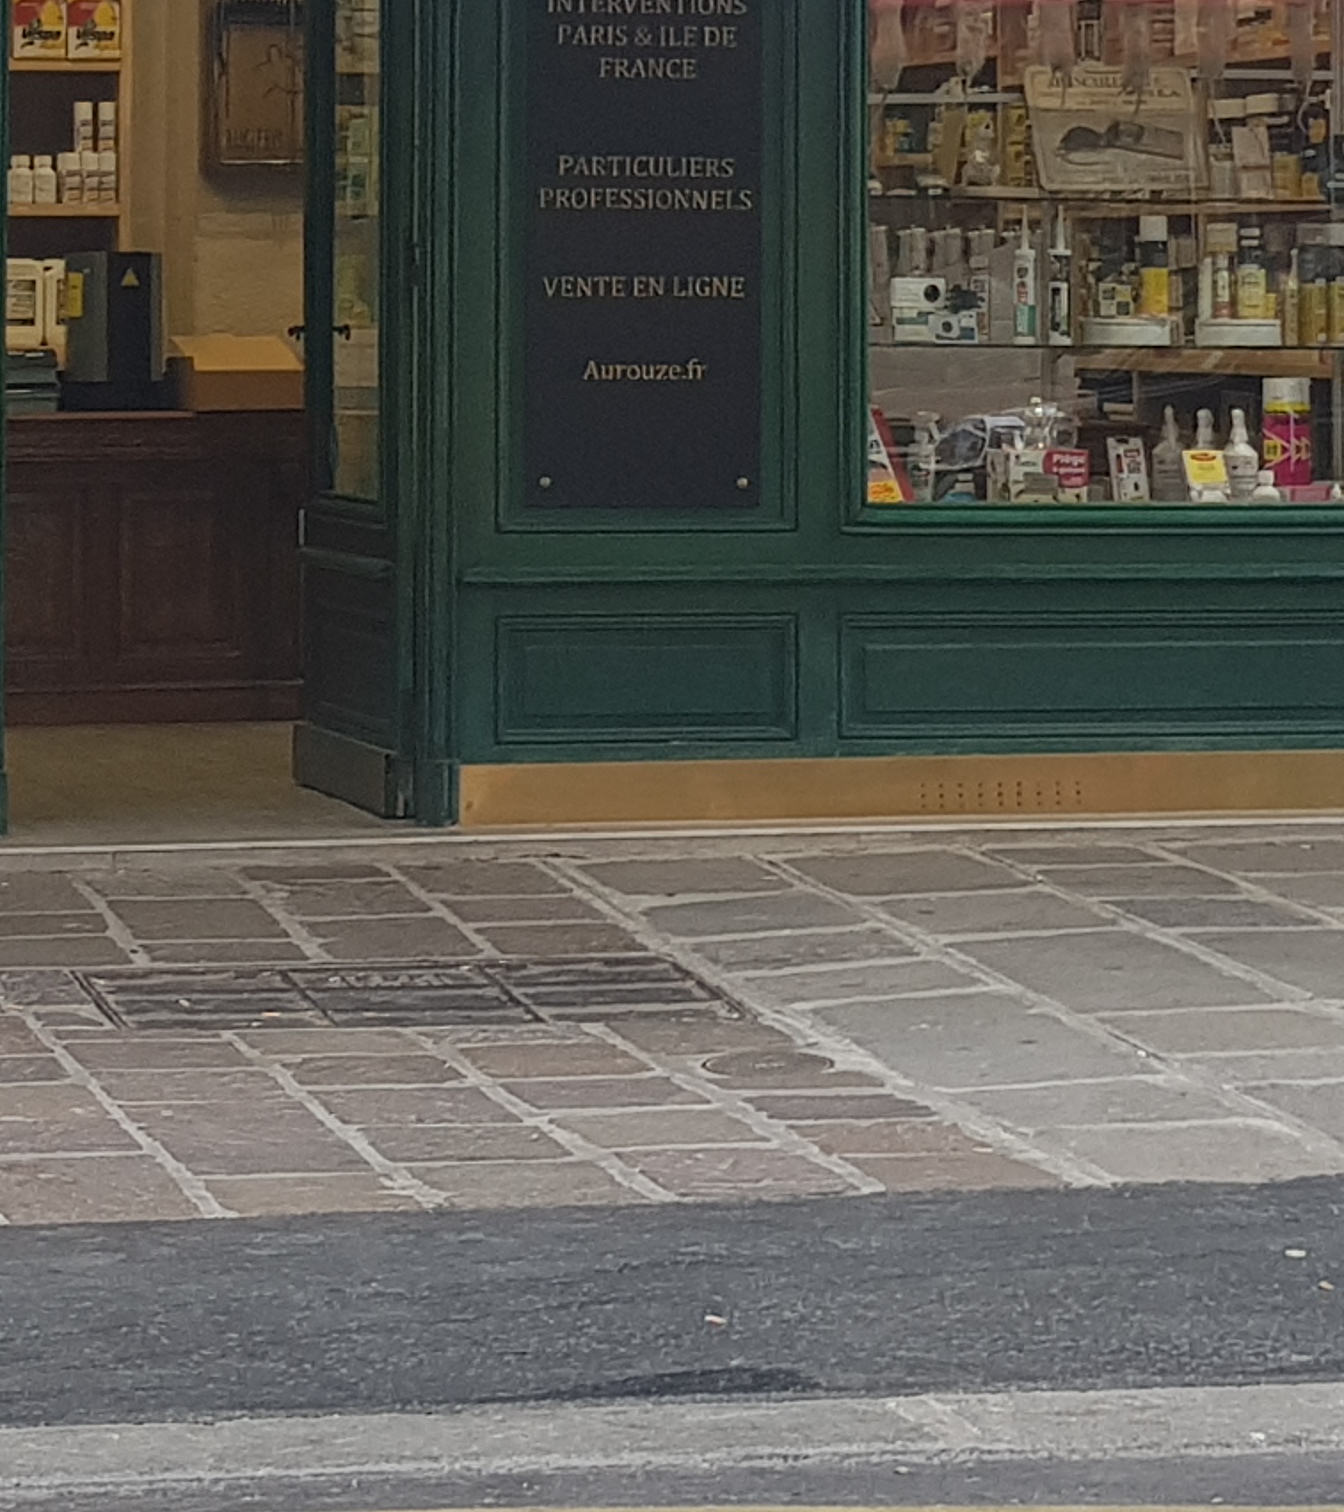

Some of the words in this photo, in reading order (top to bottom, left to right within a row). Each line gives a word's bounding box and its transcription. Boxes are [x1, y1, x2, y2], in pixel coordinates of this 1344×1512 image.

[558, 24, 627, 47] PARIS
[634, 27, 653, 47] &
[660, 26, 698, 48] ILE
[704, 26, 738, 49] DE
[599, 57, 697, 80] FRANCE
[559, 155, 735, 178] PARTICULIERS
[539, 187, 753, 210] PROFESSIONNELS
[543, 276, 626, 299] VENTE
[633, 276, 665, 298] EN
[673, 276, 746, 299] LIGNE
[582, 358, 707, 381] Aurouze.fr
